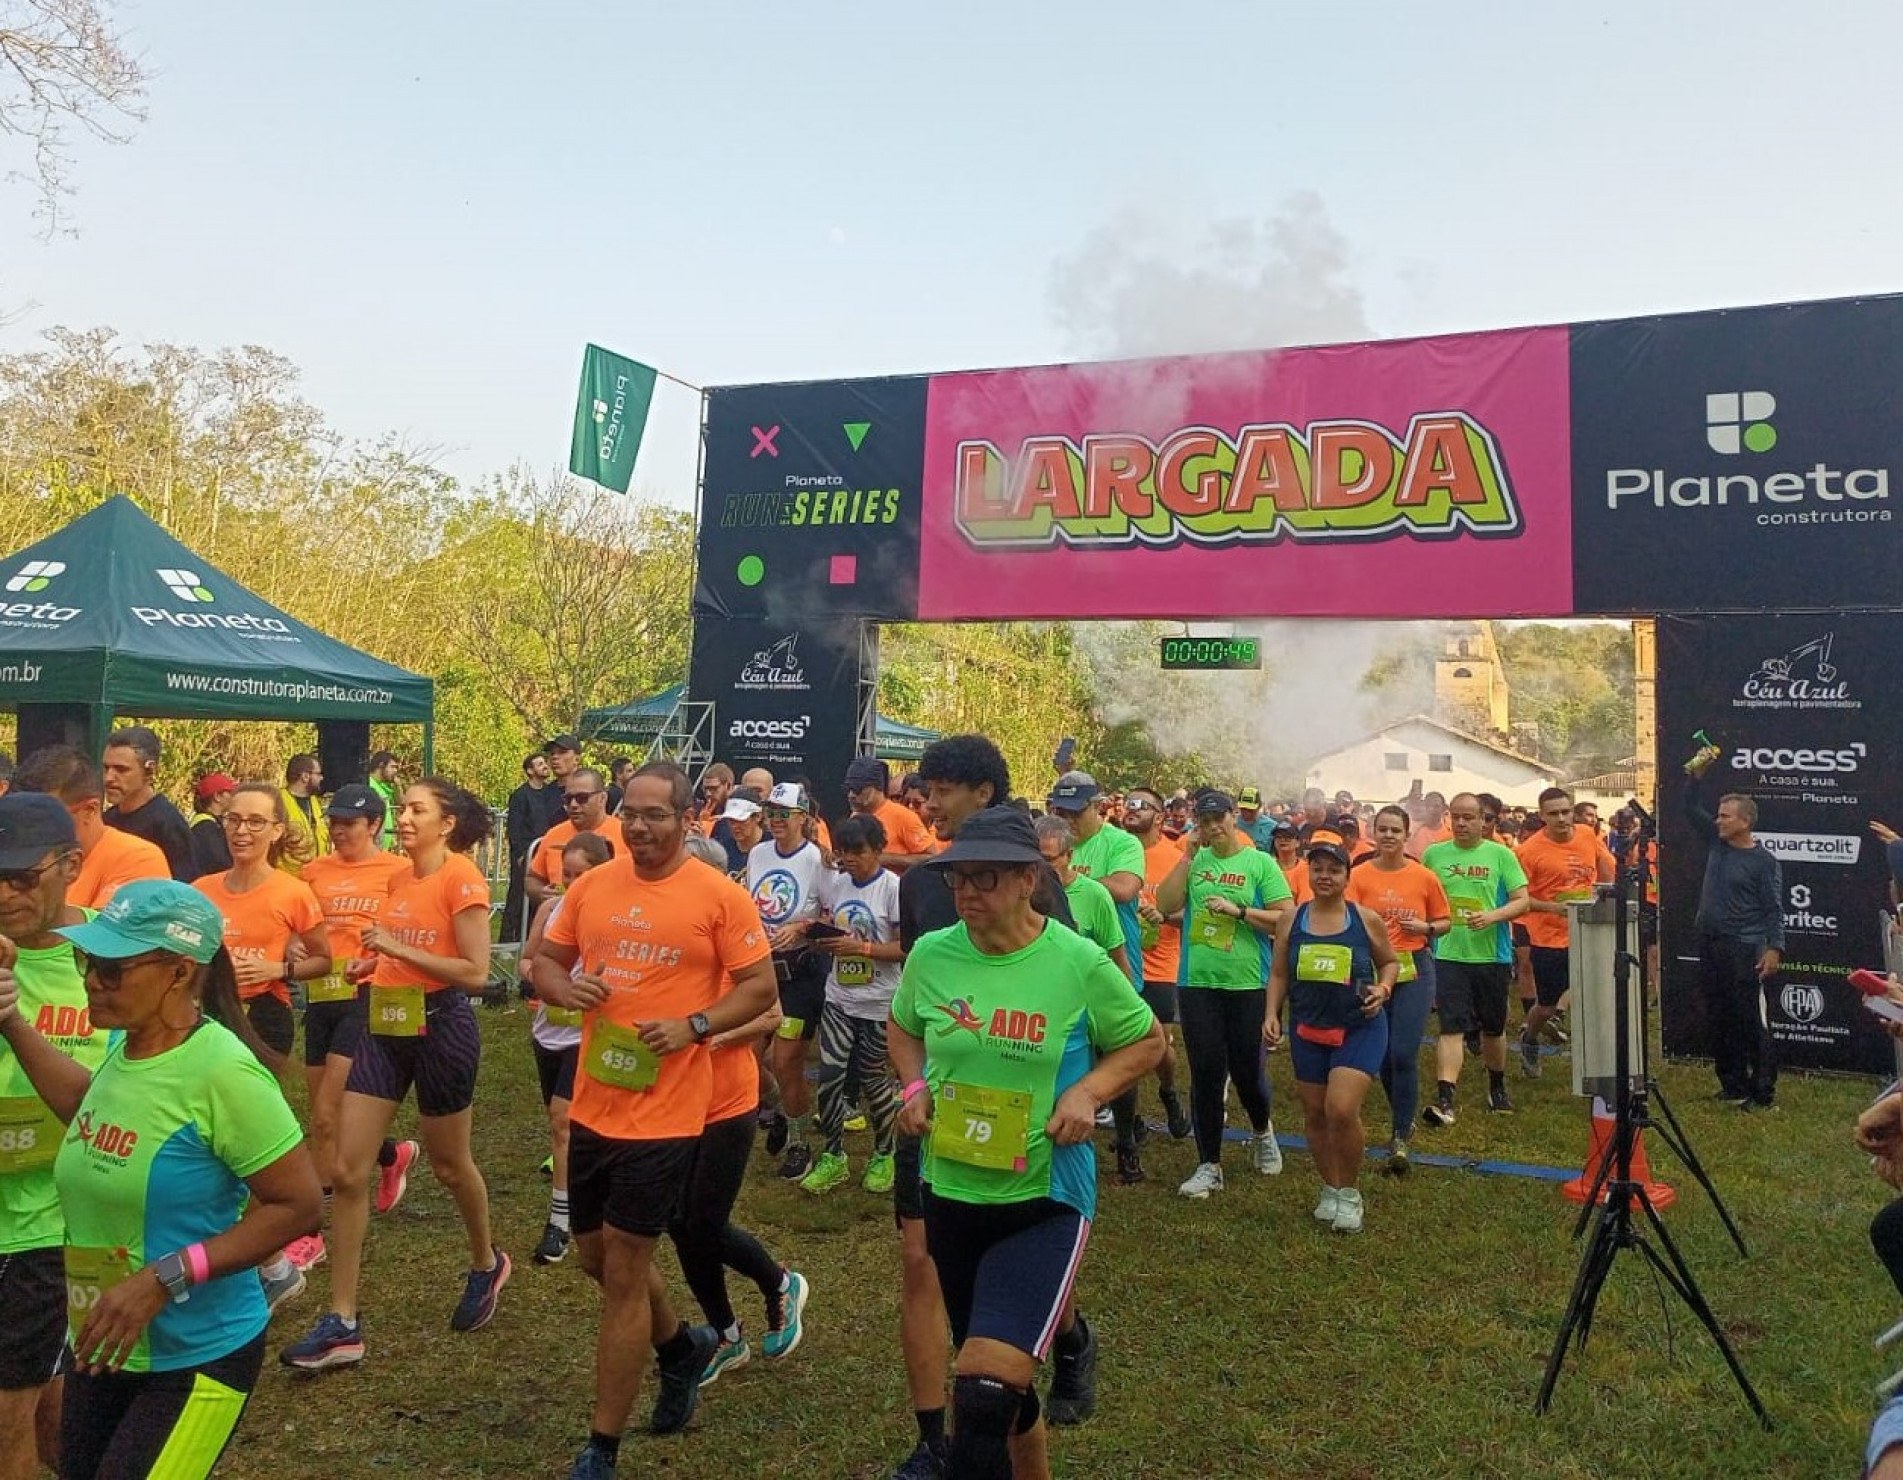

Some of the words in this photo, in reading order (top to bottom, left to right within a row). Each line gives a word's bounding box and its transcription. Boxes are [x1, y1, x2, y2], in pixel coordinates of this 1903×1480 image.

[600, 375, 630, 460] Planeta
[785, 475, 843, 487] Planeta
[954, 411, 1521, 549] LARGADA
[1606, 463, 1889, 509] Planeta
[791, 489, 900, 526] SERIES
[1756, 508, 1892, 526] construtora
[131, 606, 291, 634] Planeta
[767, 667, 804, 683] Azul
[166, 671, 393, 704] www.construtoraplaneta.com.br
[1743, 680, 1783, 699] Céu
[1788, 679, 1850, 699] Azul
[729, 719, 804, 739] access
[1731, 747, 1857, 772] access
[1759, 773, 1768, 784] A
[1802, 793, 1858, 804] Planeta
[1764, 838, 1854, 854] quartzolit
[332, 896, 380, 912] SERIES
[1781, 911, 1838, 928] eritec
[616, 939, 681, 966] SERIES
[988, 1008, 1047, 1043] ADC
[985, 1037, 1043, 1054] RUNNING
[601, 1050, 637, 1072] 439
[92, 1123, 138, 1157] ADC
[964, 1117, 992, 1144] 79
